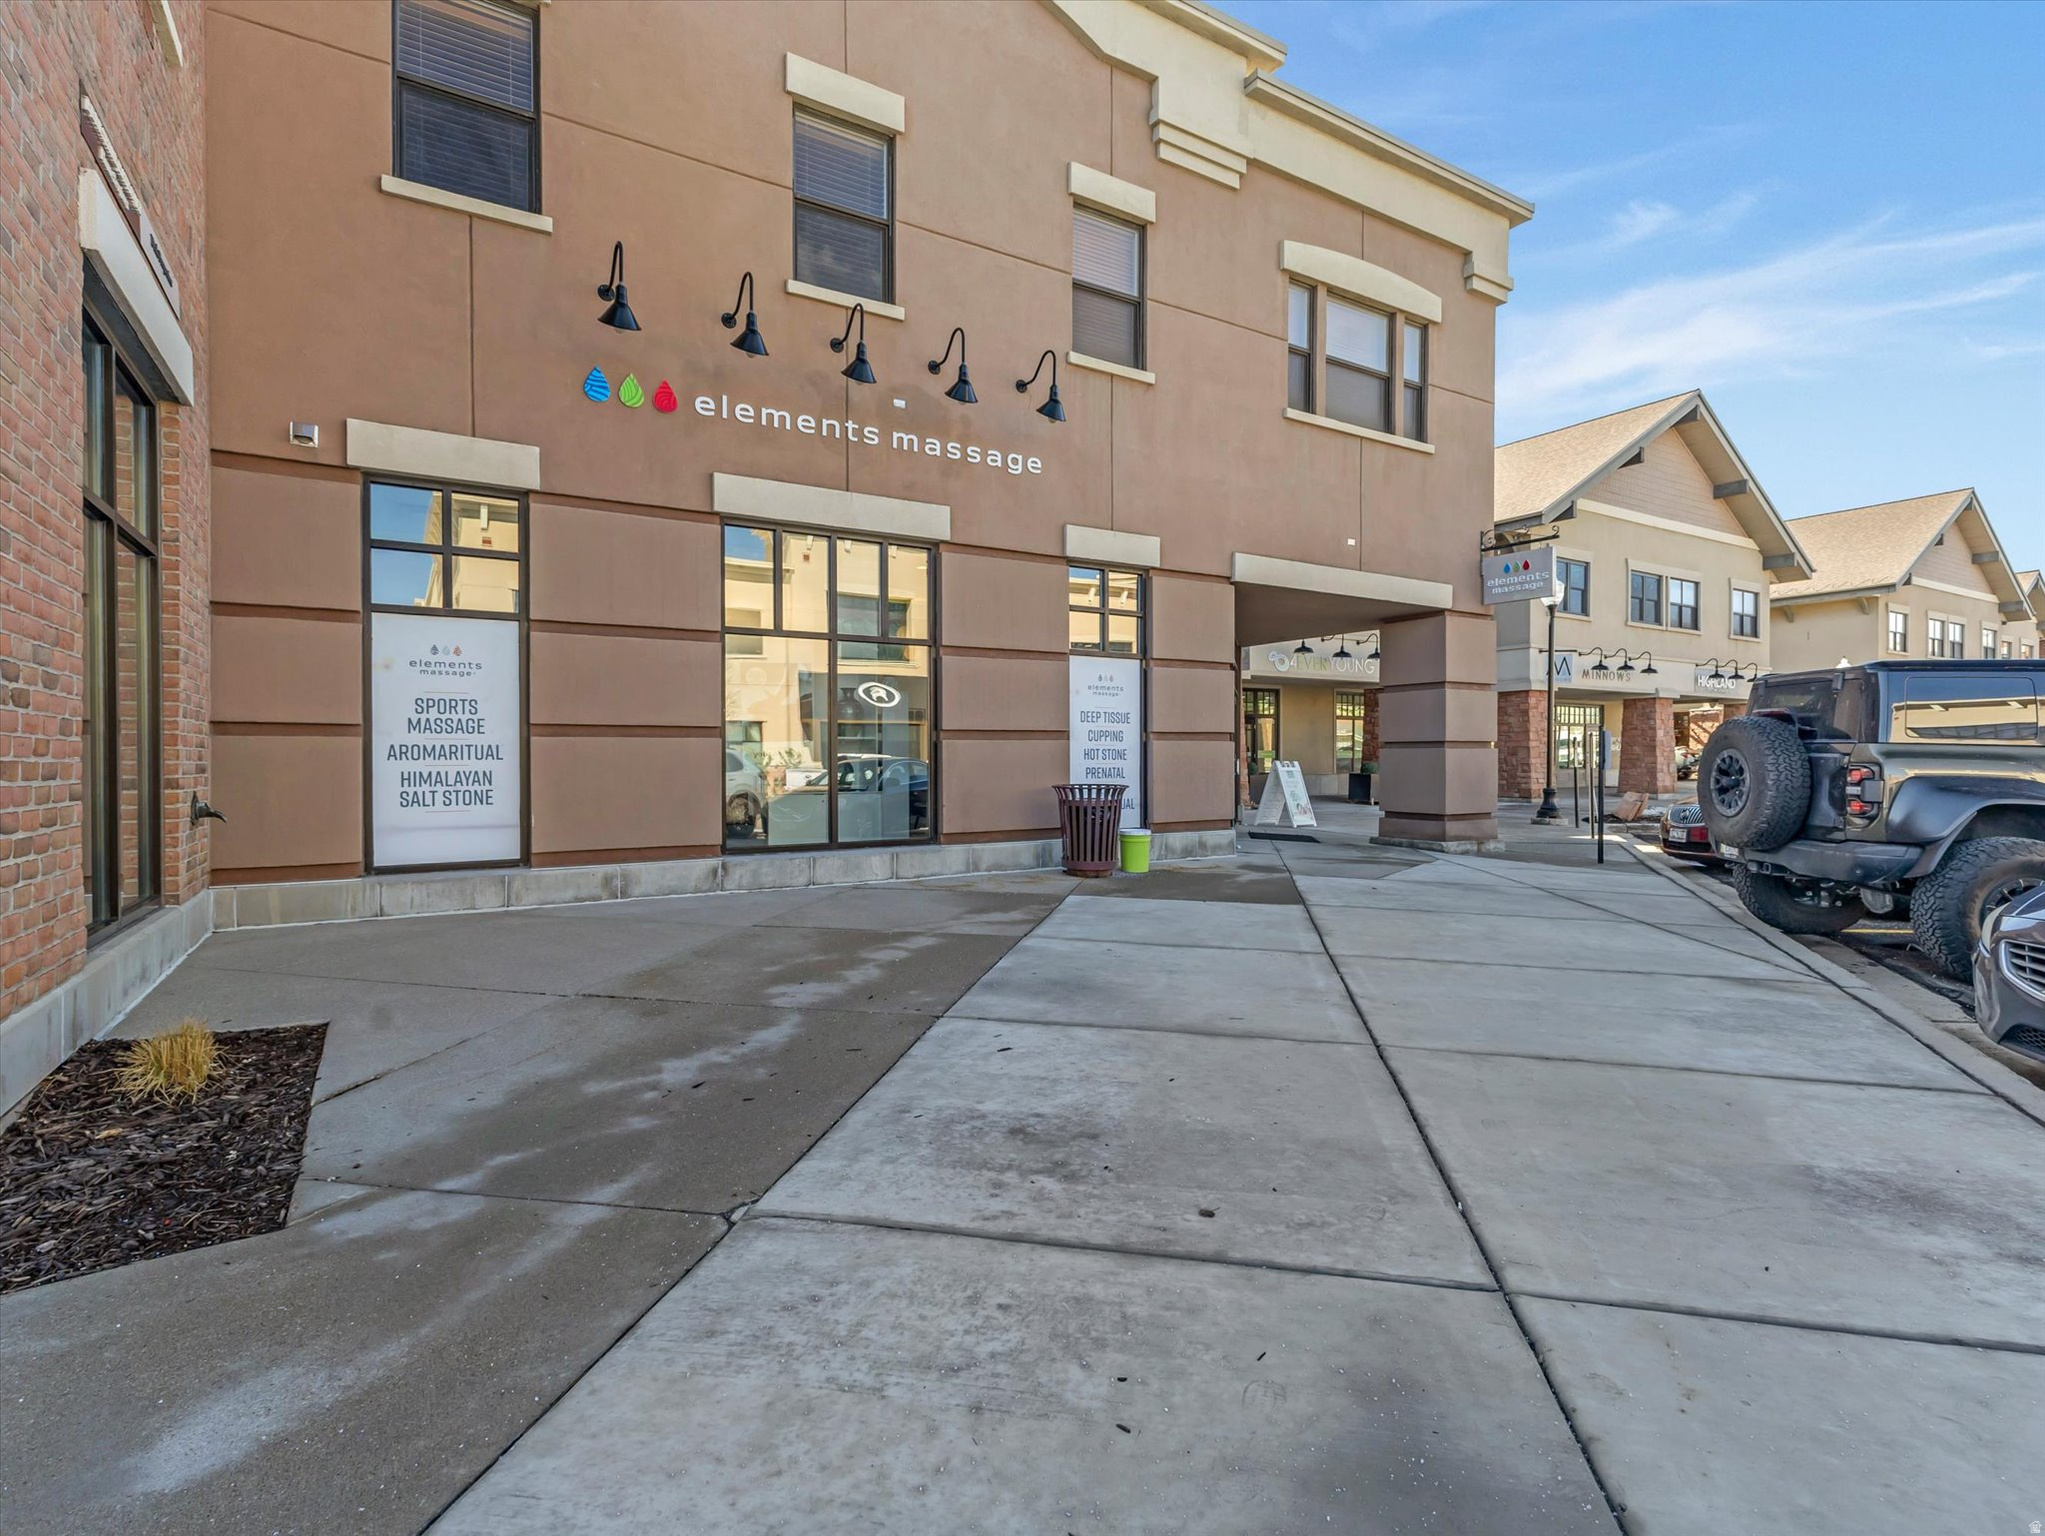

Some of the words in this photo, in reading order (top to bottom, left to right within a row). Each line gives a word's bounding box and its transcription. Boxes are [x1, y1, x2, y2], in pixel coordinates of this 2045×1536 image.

[693, 394, 879, 446] elements
[891, 430, 1043, 475] massage
[1487, 571, 1549, 587] elements
[1492, 581, 1544, 594] massage
[409, 658, 483, 670] elements
[419, 669, 473, 678] massage
[1581, 668, 1631, 682] MINNOWS
[1087, 684, 1124, 692] elements
[1697, 675, 1736, 688] HIGHLAND
[414, 697, 479, 716] SPORTS
[1080, 710, 1101, 724] DEEP
[1103, 711, 1131, 724] TISSUE
[407, 717, 486, 735] MASSAGE
[1087, 729, 1124, 743] CUPPING
[386, 743, 504, 761] AROMARITUAL
[1083, 748, 1100, 761] HOT
[1101, 748, 1128, 761] STONE
[400, 770, 493, 788] HIMALAYAN
[1085, 766, 1126, 779] PRENATAL
[399, 790, 438, 808] SALT
[442, 788, 494, 807] STONE
